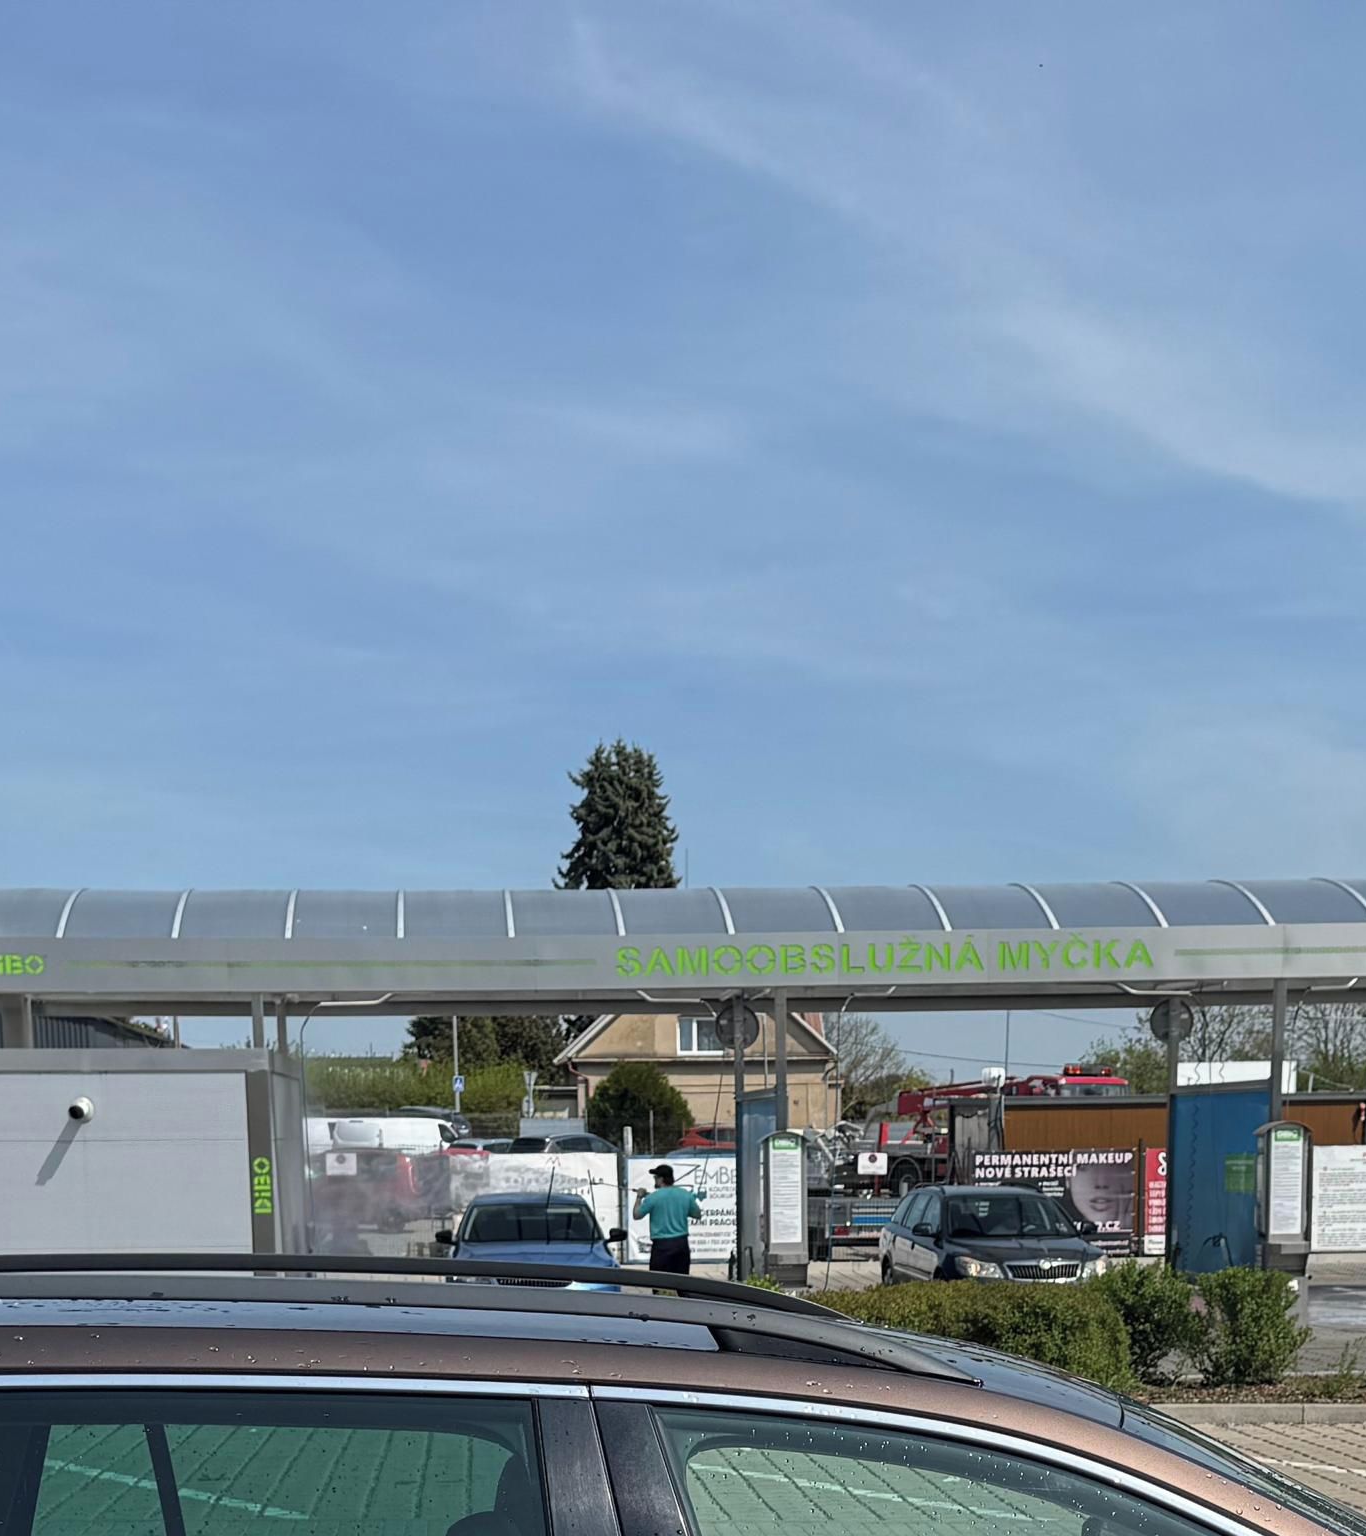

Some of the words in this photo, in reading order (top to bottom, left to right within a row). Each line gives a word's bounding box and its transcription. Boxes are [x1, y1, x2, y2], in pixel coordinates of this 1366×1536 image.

[616, 934, 984, 977] SAMOOBSLUŽNÁ
[997, 932, 1154, 971] MYČKA
[975, 1150, 1073, 1166] PERMANENTNÍ
[1076, 1152, 1133, 1164] MAKEUP
[975, 1163, 1012, 1178] NOVÉ
[1014, 1163, 1077, 1178] STRAŠECÍ
